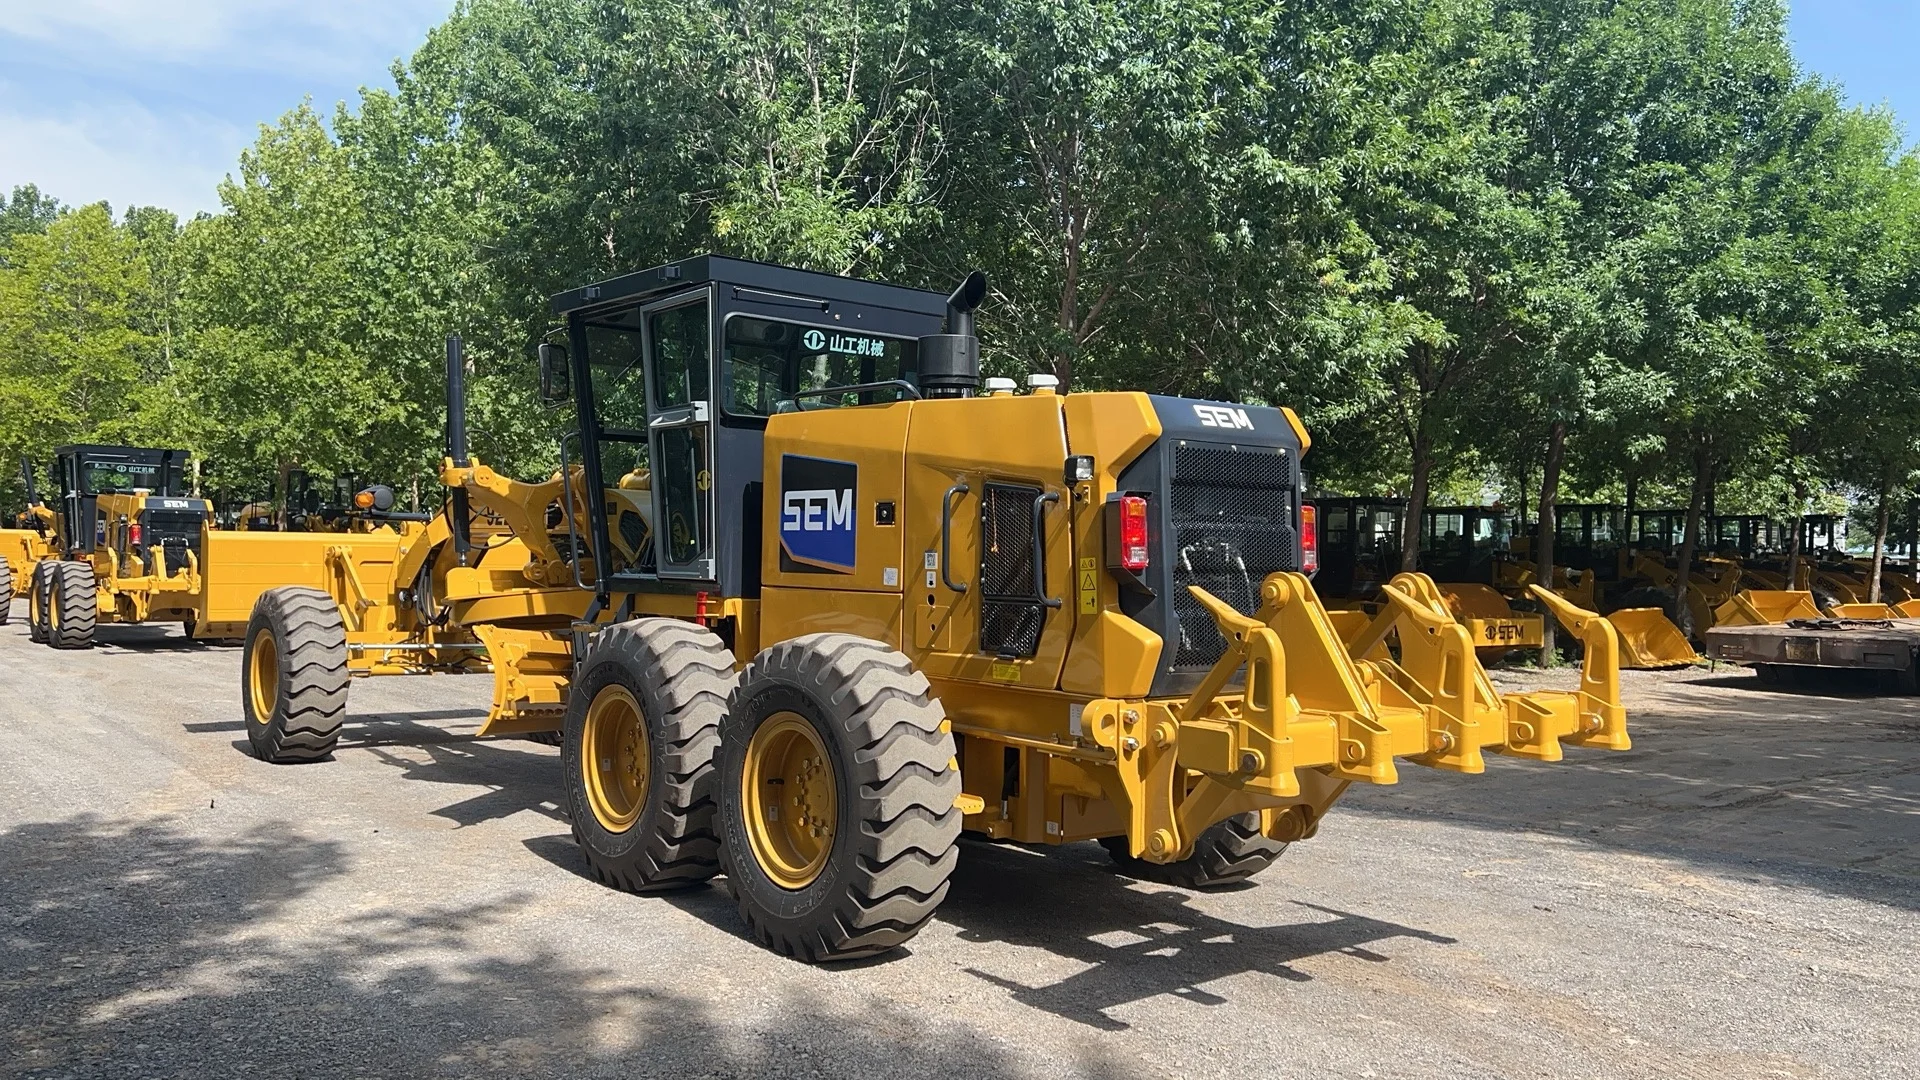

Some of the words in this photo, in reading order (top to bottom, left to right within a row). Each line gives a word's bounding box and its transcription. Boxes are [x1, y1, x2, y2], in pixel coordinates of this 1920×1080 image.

[829, 334, 885, 357] 山工机械
[1193, 404, 1255, 430] SEM
[128, 465, 155, 474] 山工机械
[163, 500, 189, 508] SEM
[783, 488, 853, 531] SEM
[1499, 625, 1524, 640] SEM
